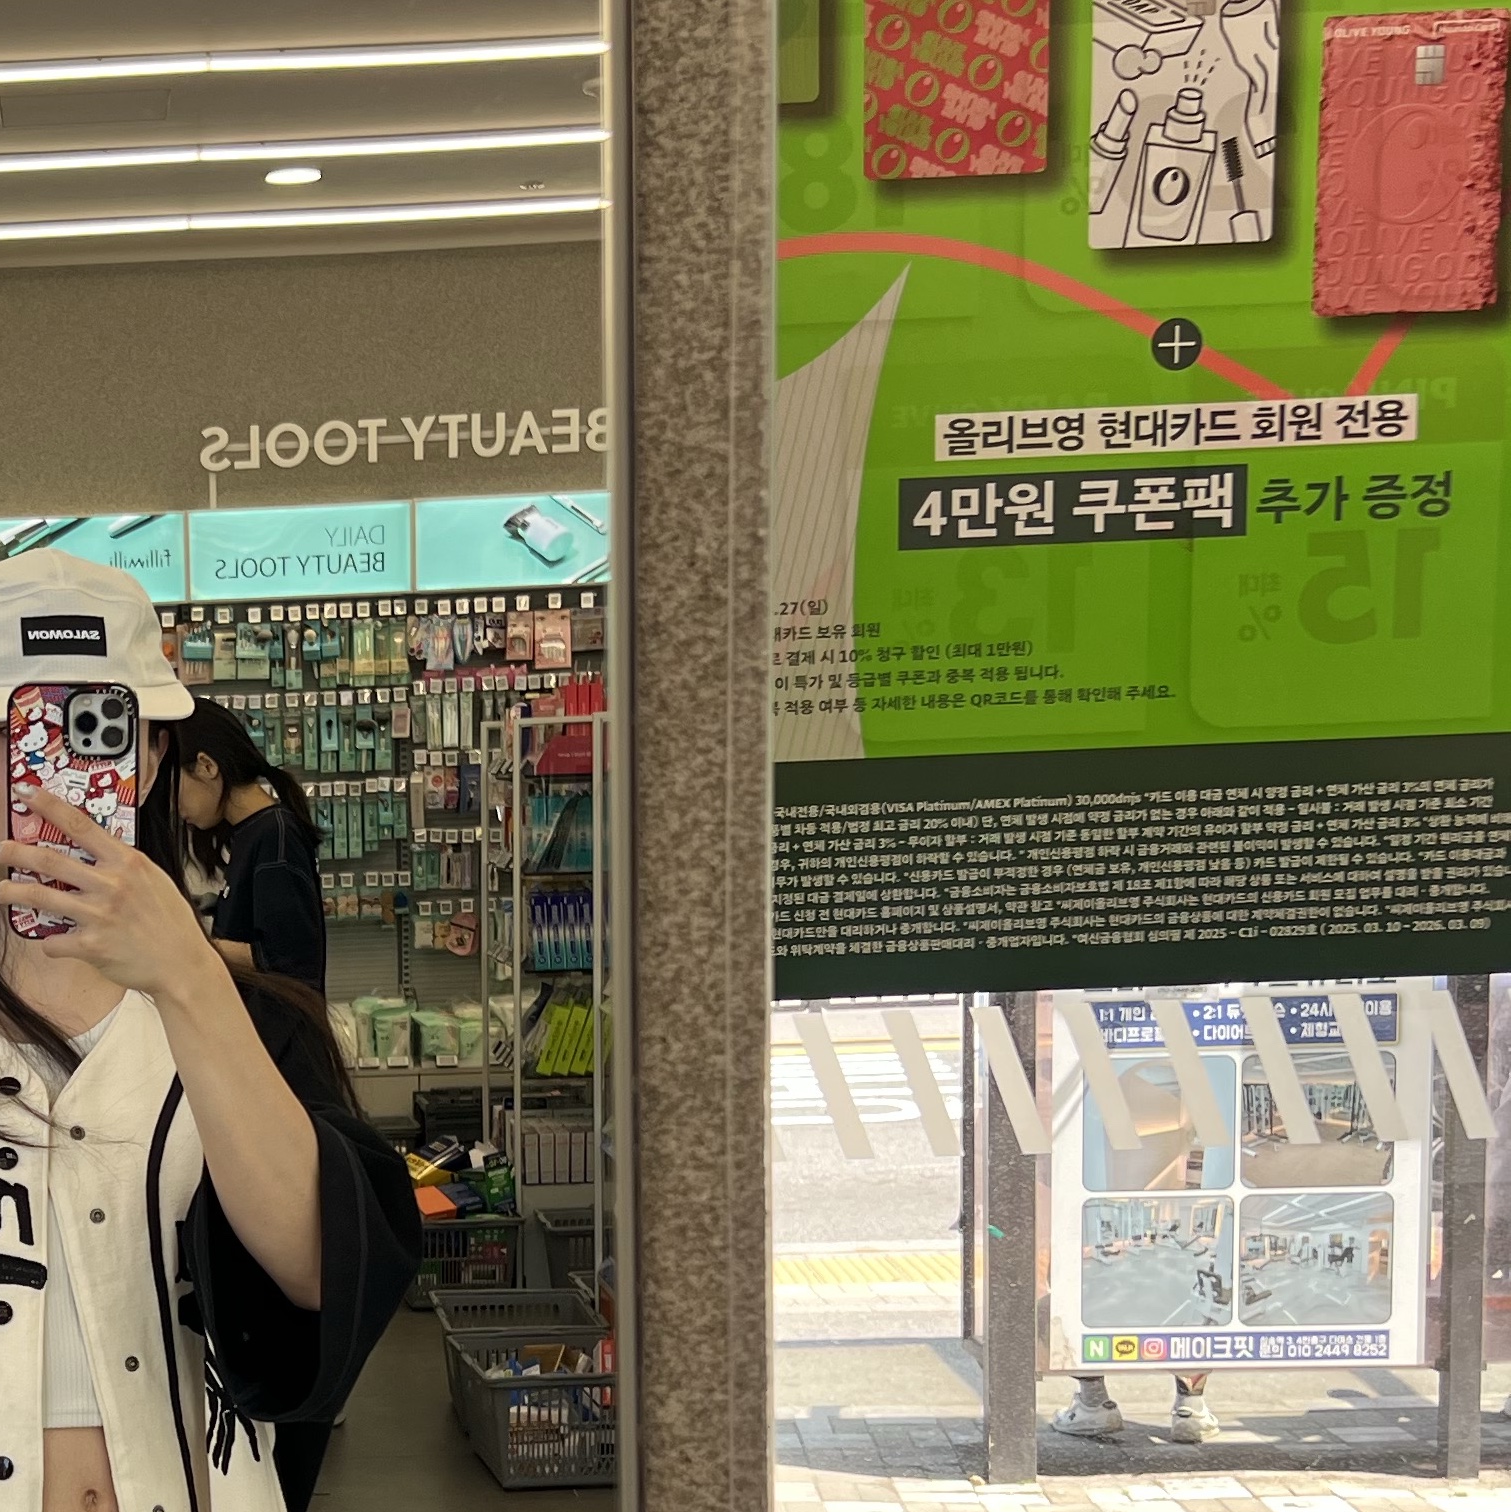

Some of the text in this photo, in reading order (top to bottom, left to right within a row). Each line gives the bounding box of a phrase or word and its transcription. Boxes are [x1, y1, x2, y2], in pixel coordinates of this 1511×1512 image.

[1335, 25, 1410, 38] OLIVE YOUNG
[943, 399, 1409, 456] 올리브영 현대카드 회원 전용
[912, 469, 1454, 539] 4만원 쿠폰팩 추가 증정
[817, 623, 880, 639] 보유 회원
[786, 640, 1033, 666] 결제 시 10% 청구 할인 (최대 1만원)
[793, 675, 823, 690] 특가
[828, 674, 842, 689] 및
[846, 671, 891, 688] 등급별
[897, 670, 940, 685] 쿠폰과
[946, 668, 975, 684] 중복
[980, 666, 1009, 682] 적용
[1014, 664, 1064, 681] 됩니다.
[784, 685, 1175, 715] 적용 여부 등 자세한 내용은 QR코드를 통해 확인해 주세요.
[898, 819, 920, 832] 금리
[923, 818, 949, 829] 20%
[853, 838, 876, 850] 금리
[837, 873, 849, 885] 수
[851, 871, 901, 885] 있습니다.
[1198, 928, 1227, 940] 2025
[1119, 1007, 1146, 1022] 개인
[1203, 1008, 1222, 1019] 2:1
[1170, 1336, 1254, 1358] 메이크핏
[1288, 1345, 1311, 1356] 010
[1315, 1344, 1349, 1356] 2449
[1354, 1344, 1386, 1356] 8252
